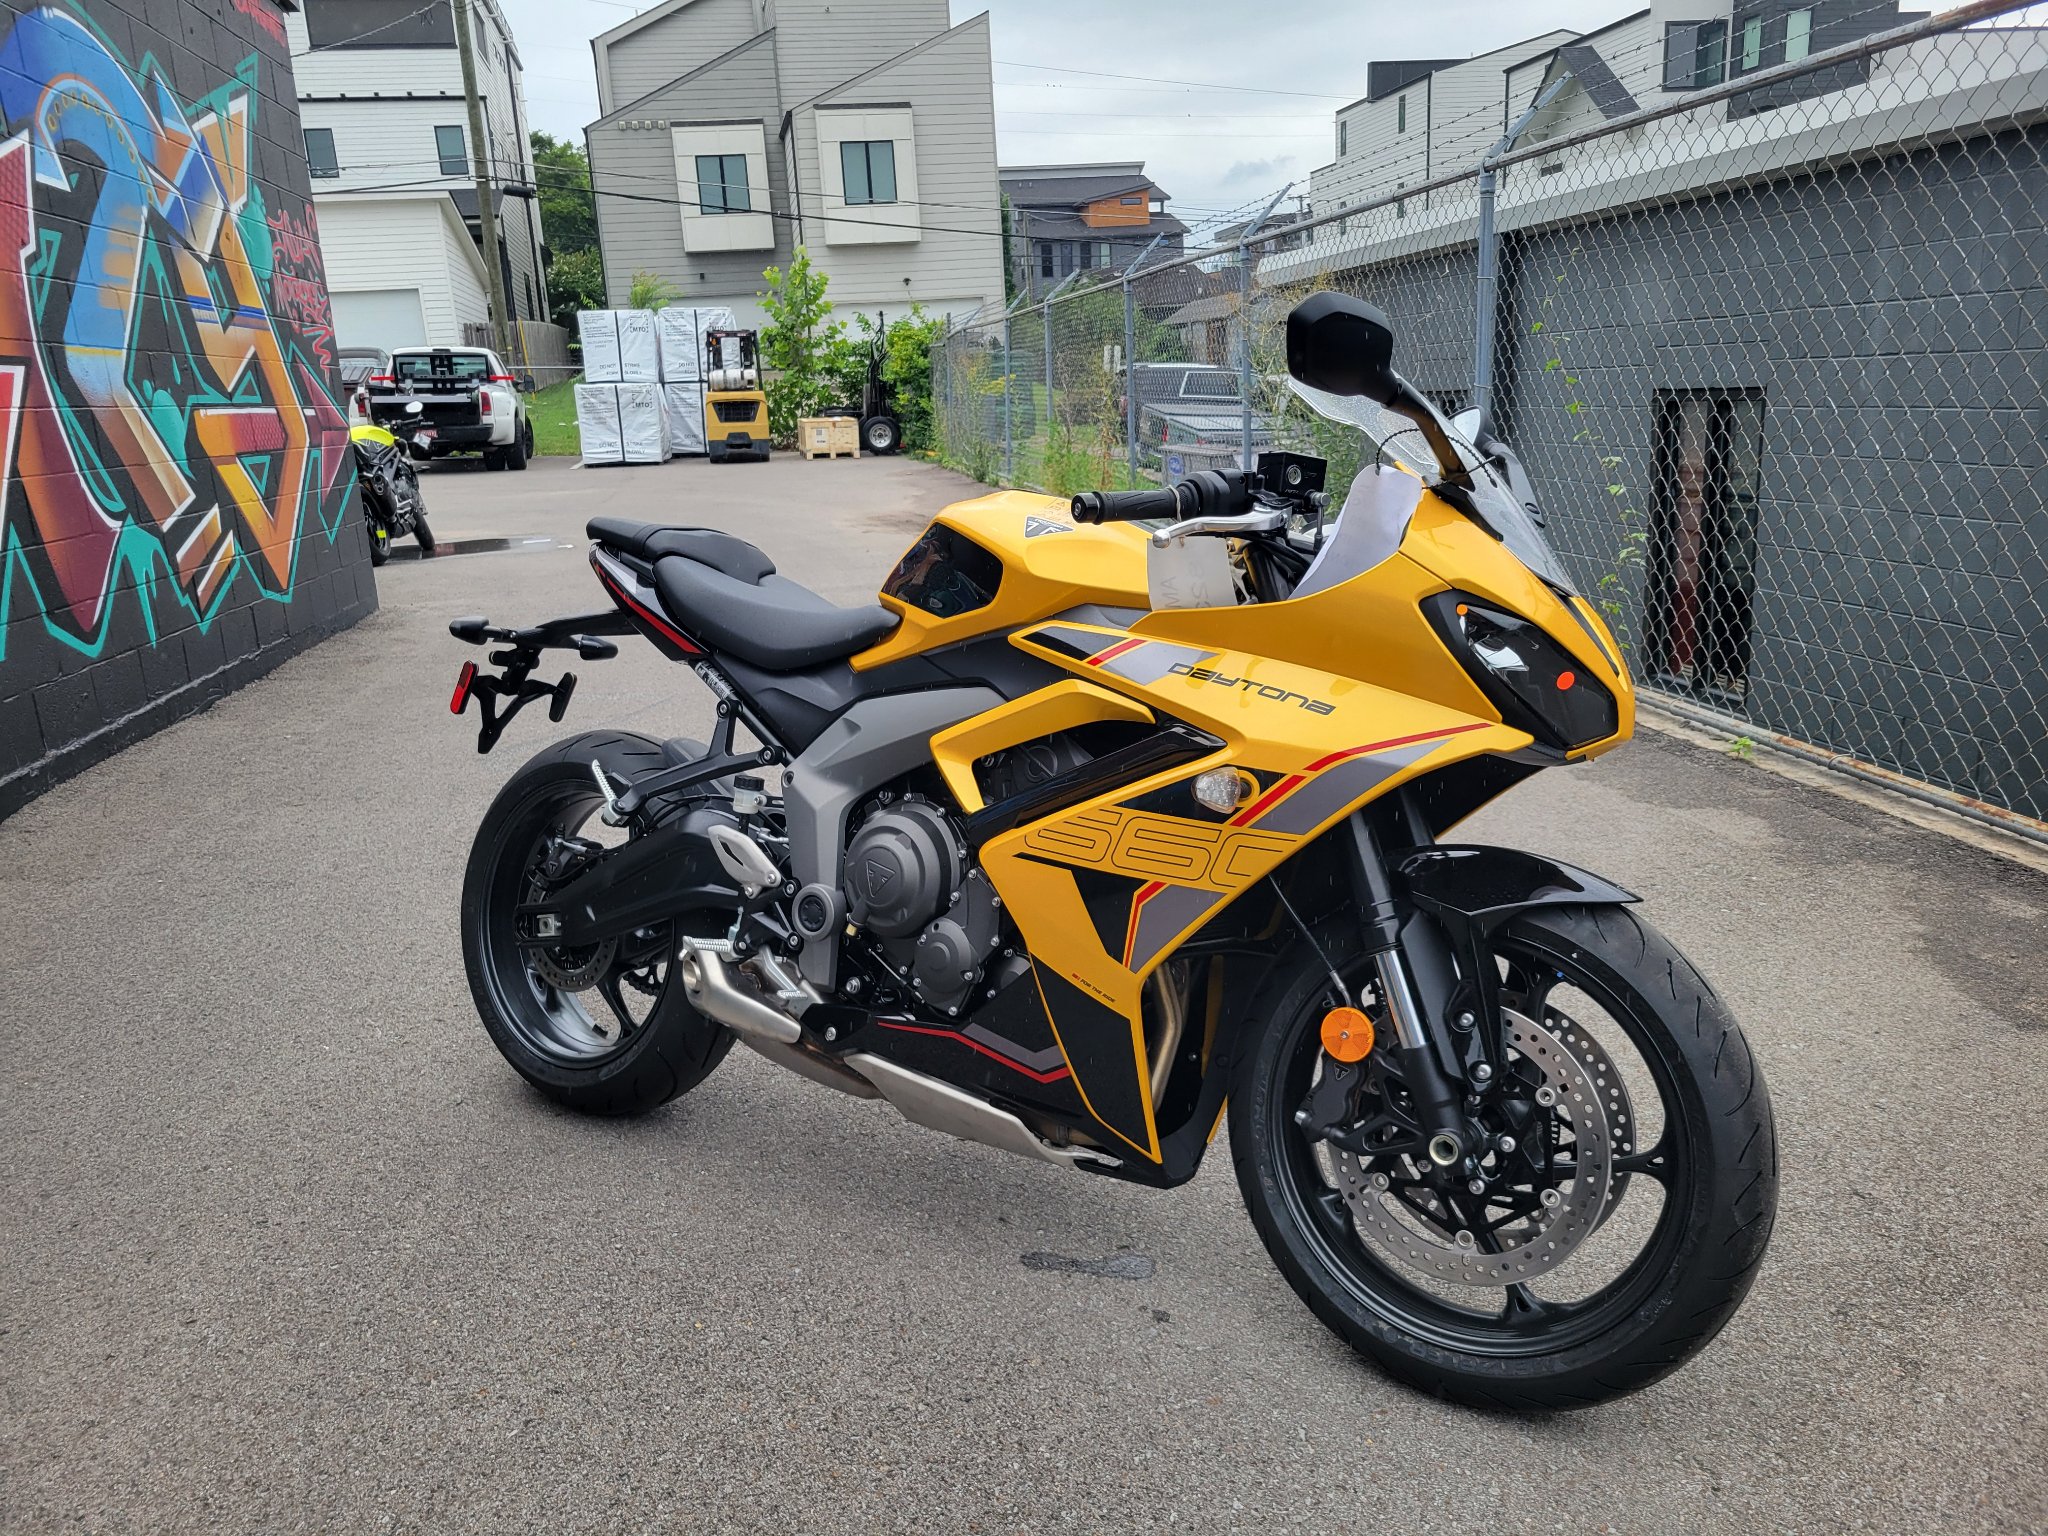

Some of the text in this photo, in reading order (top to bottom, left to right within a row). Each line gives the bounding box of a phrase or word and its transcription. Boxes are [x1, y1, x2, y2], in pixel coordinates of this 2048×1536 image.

[1167, 662, 1337, 717] DAYTONA
[1080, 978, 1116, 1004] FOR THE RIDE
